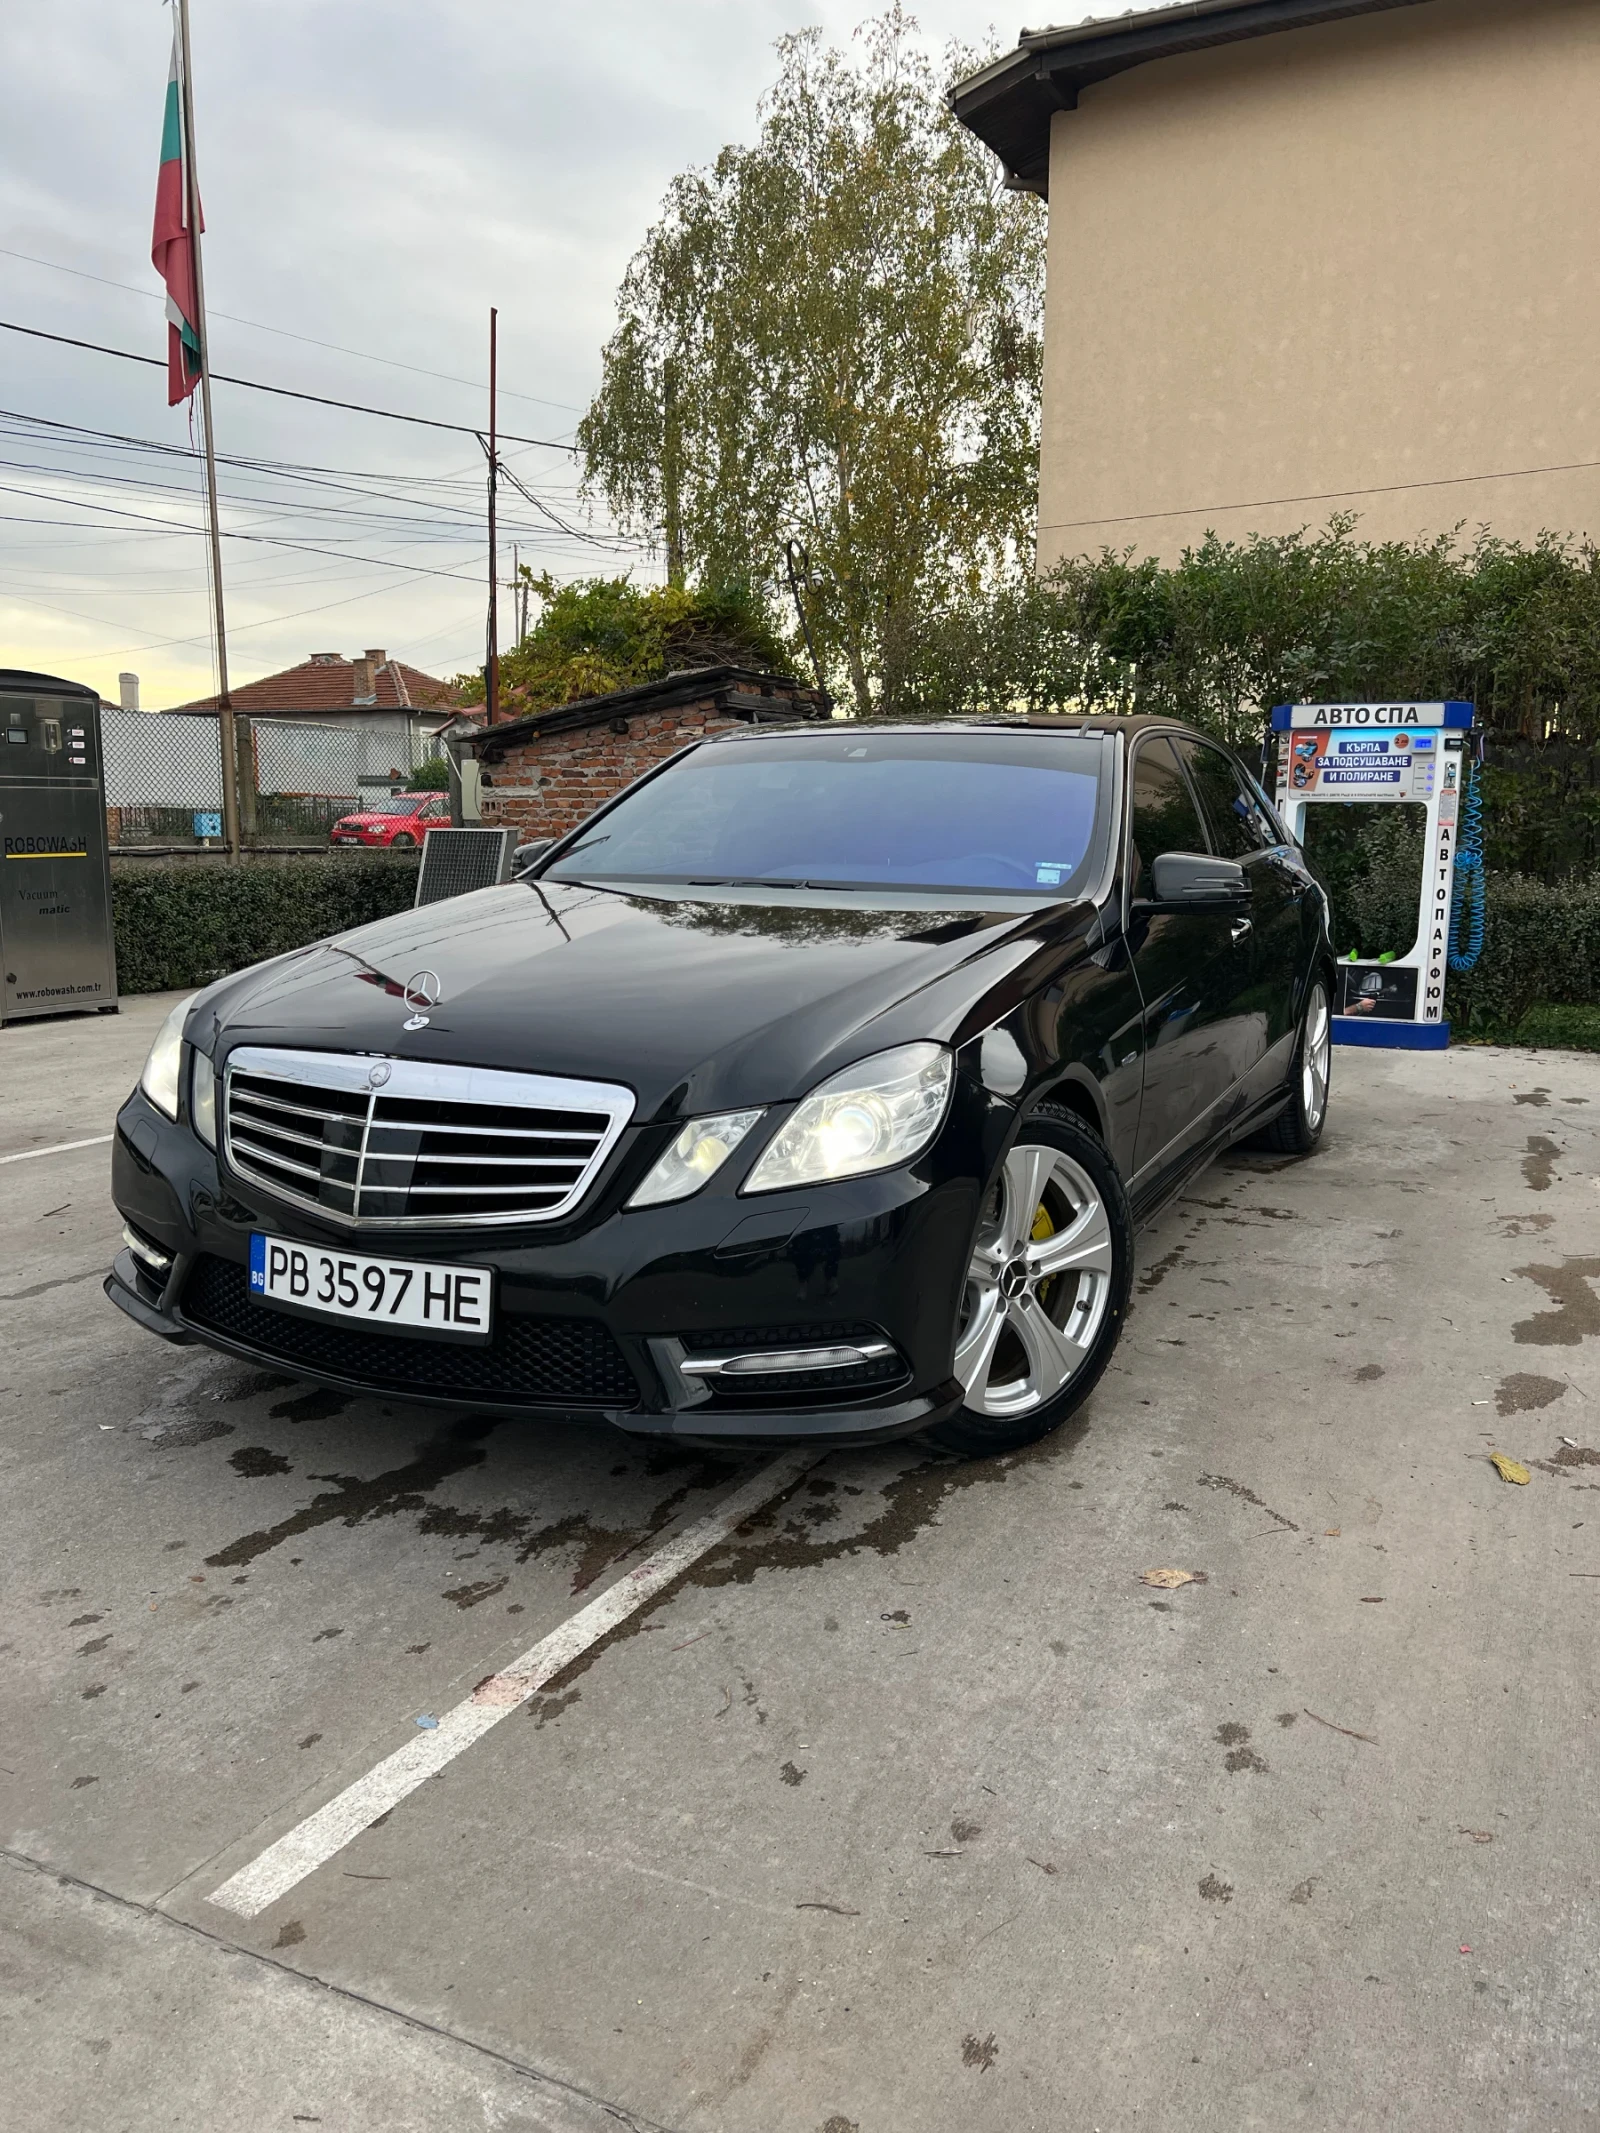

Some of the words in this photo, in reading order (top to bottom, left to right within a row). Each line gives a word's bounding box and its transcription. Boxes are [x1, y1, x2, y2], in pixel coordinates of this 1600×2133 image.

[1314, 707, 1370, 724] АВТО
[1374, 706, 1419, 723] СПА
[1346, 743, 1381, 753] КЪРПА
[1317, 757, 1330, 767] ЗА
[1332, 756, 1409, 767] ПОДСУШАВАНЕ
[1329, 772, 1337, 781] И
[1339, 772, 1394, 781] ПОЛИРАНЕ
[4, 836, 87, 853] ROBOWASH
[19, 890, 58, 900] Vacuum
[39, 905, 71, 915] matic
[16, 982, 101, 999] www.robowash.com.tr
[251, 1270, 264, 1286] BG
[269, 1244, 309, 1297] PB
[317, 1257, 413, 1315] 3597
[423, 1271, 481, 1326] HE
